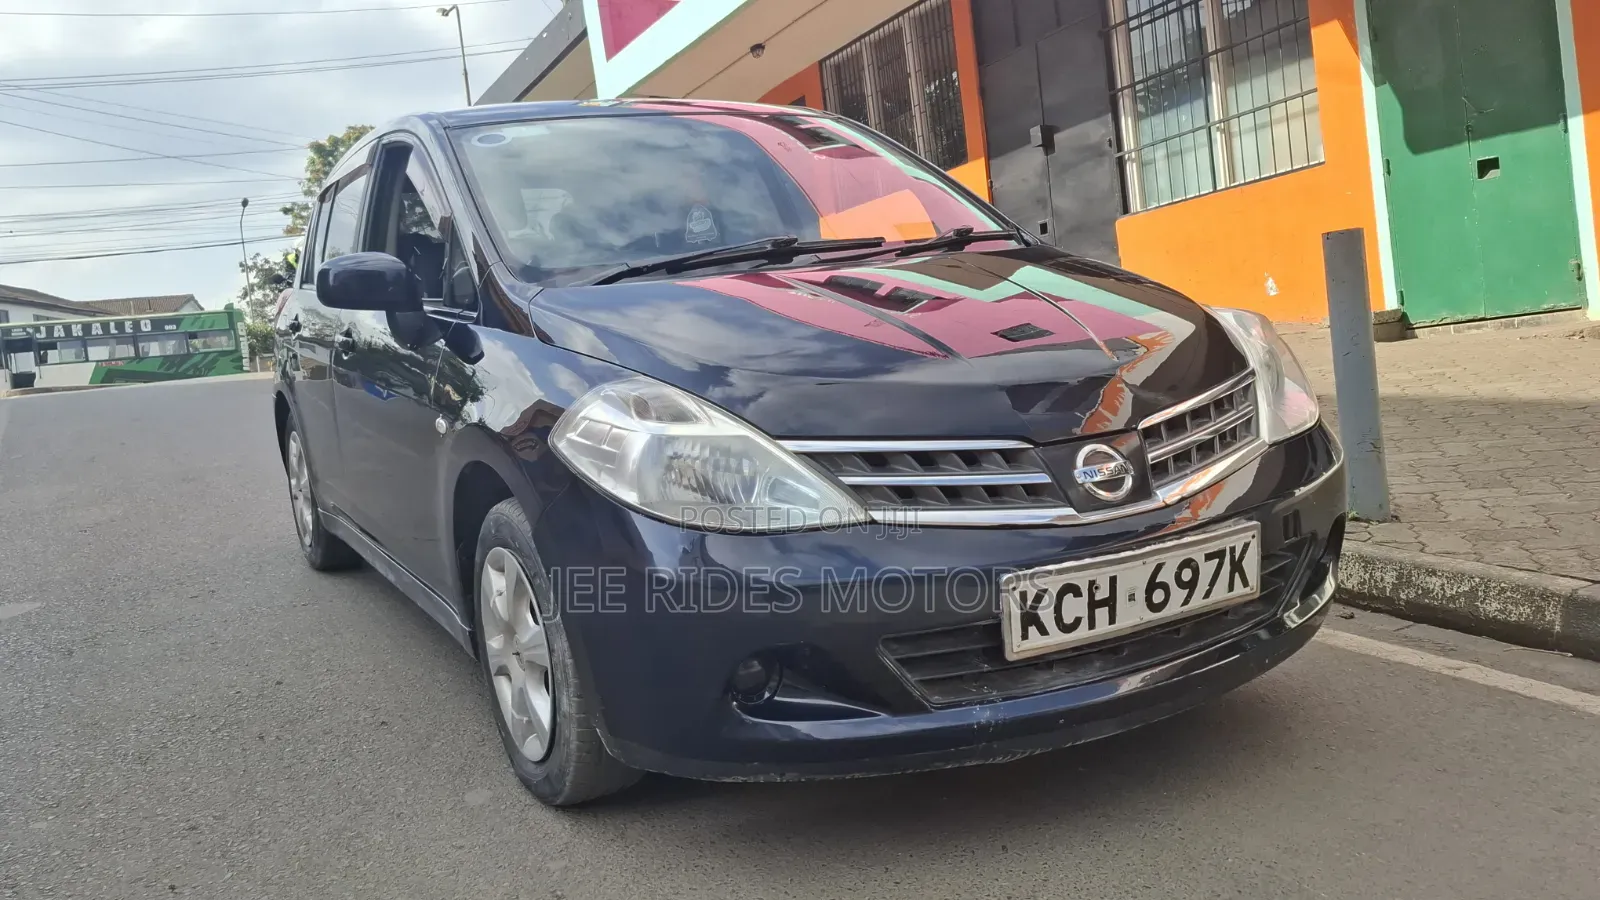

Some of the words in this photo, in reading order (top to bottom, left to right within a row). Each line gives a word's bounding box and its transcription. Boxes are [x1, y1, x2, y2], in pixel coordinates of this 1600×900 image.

[1083, 462, 1129, 480] NISSAN
[1020, 575, 1118, 641] KCH
[1144, 540, 1252, 613] 697K
